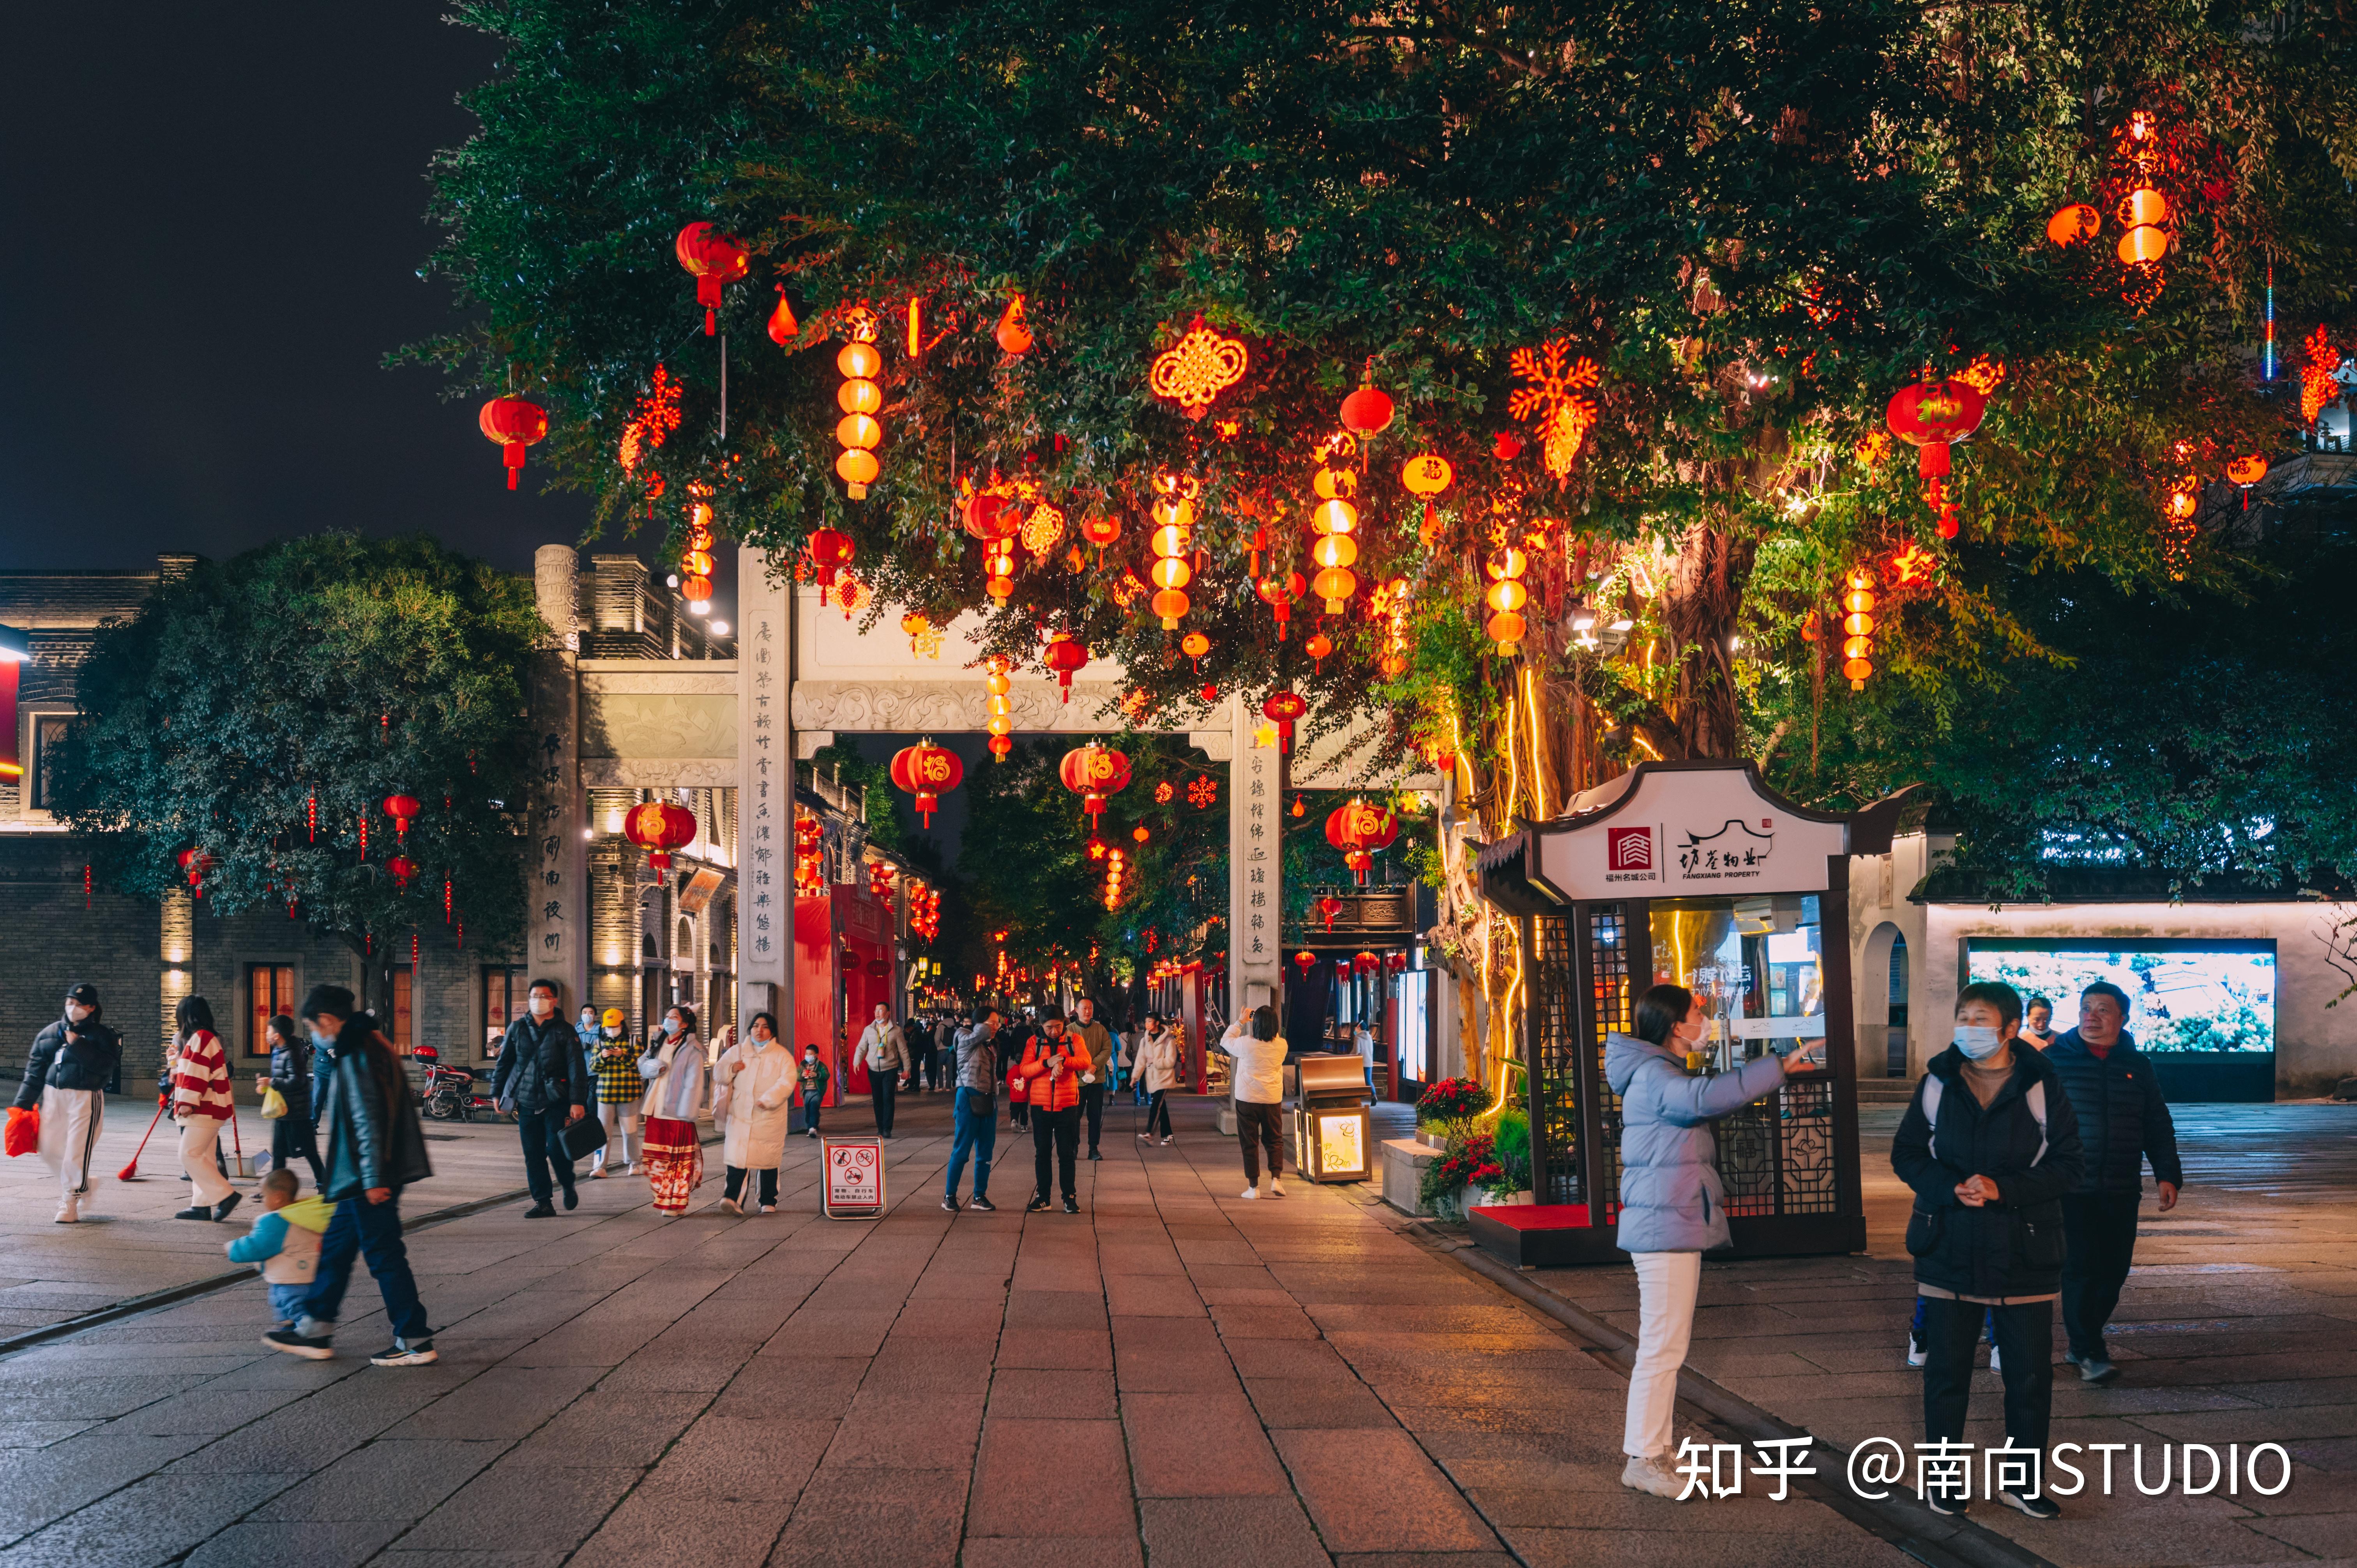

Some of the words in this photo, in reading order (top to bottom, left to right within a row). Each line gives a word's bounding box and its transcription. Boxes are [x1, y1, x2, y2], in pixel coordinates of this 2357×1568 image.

[1422, 459, 1441, 480] 福
[923, 755, 951, 781] 福
[1087, 754, 1114, 779] 福
[636, 810, 666, 835] 福
[1605, 872, 1656, 882] 福州名城公司
